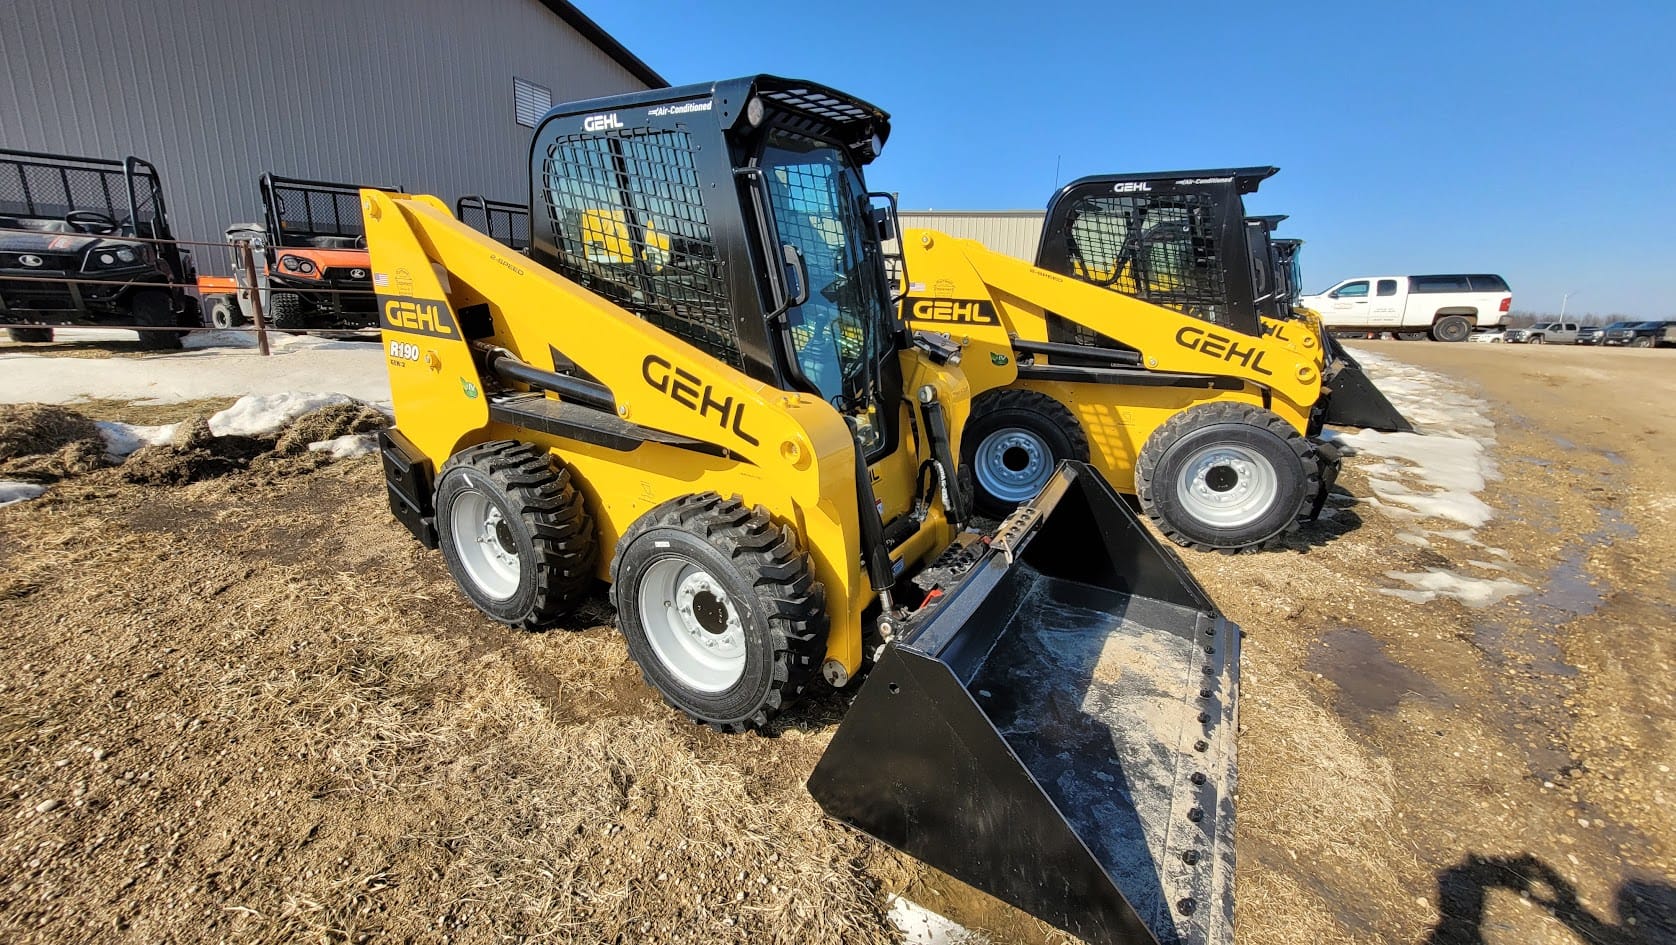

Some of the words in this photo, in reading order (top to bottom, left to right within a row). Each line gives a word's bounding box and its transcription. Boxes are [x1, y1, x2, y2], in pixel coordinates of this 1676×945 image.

[658, 100, 712, 116] Air-Conditioned
[584, 113, 623, 131] GEHL
[1114, 182, 1152, 193] GEHL
[385, 300, 451, 334] GEHL
[913, 300, 991, 323] GEHL
[390, 340, 420, 362] R190
[1175, 326, 1273, 376] GEHL
[642, 354, 759, 447] GEHL
